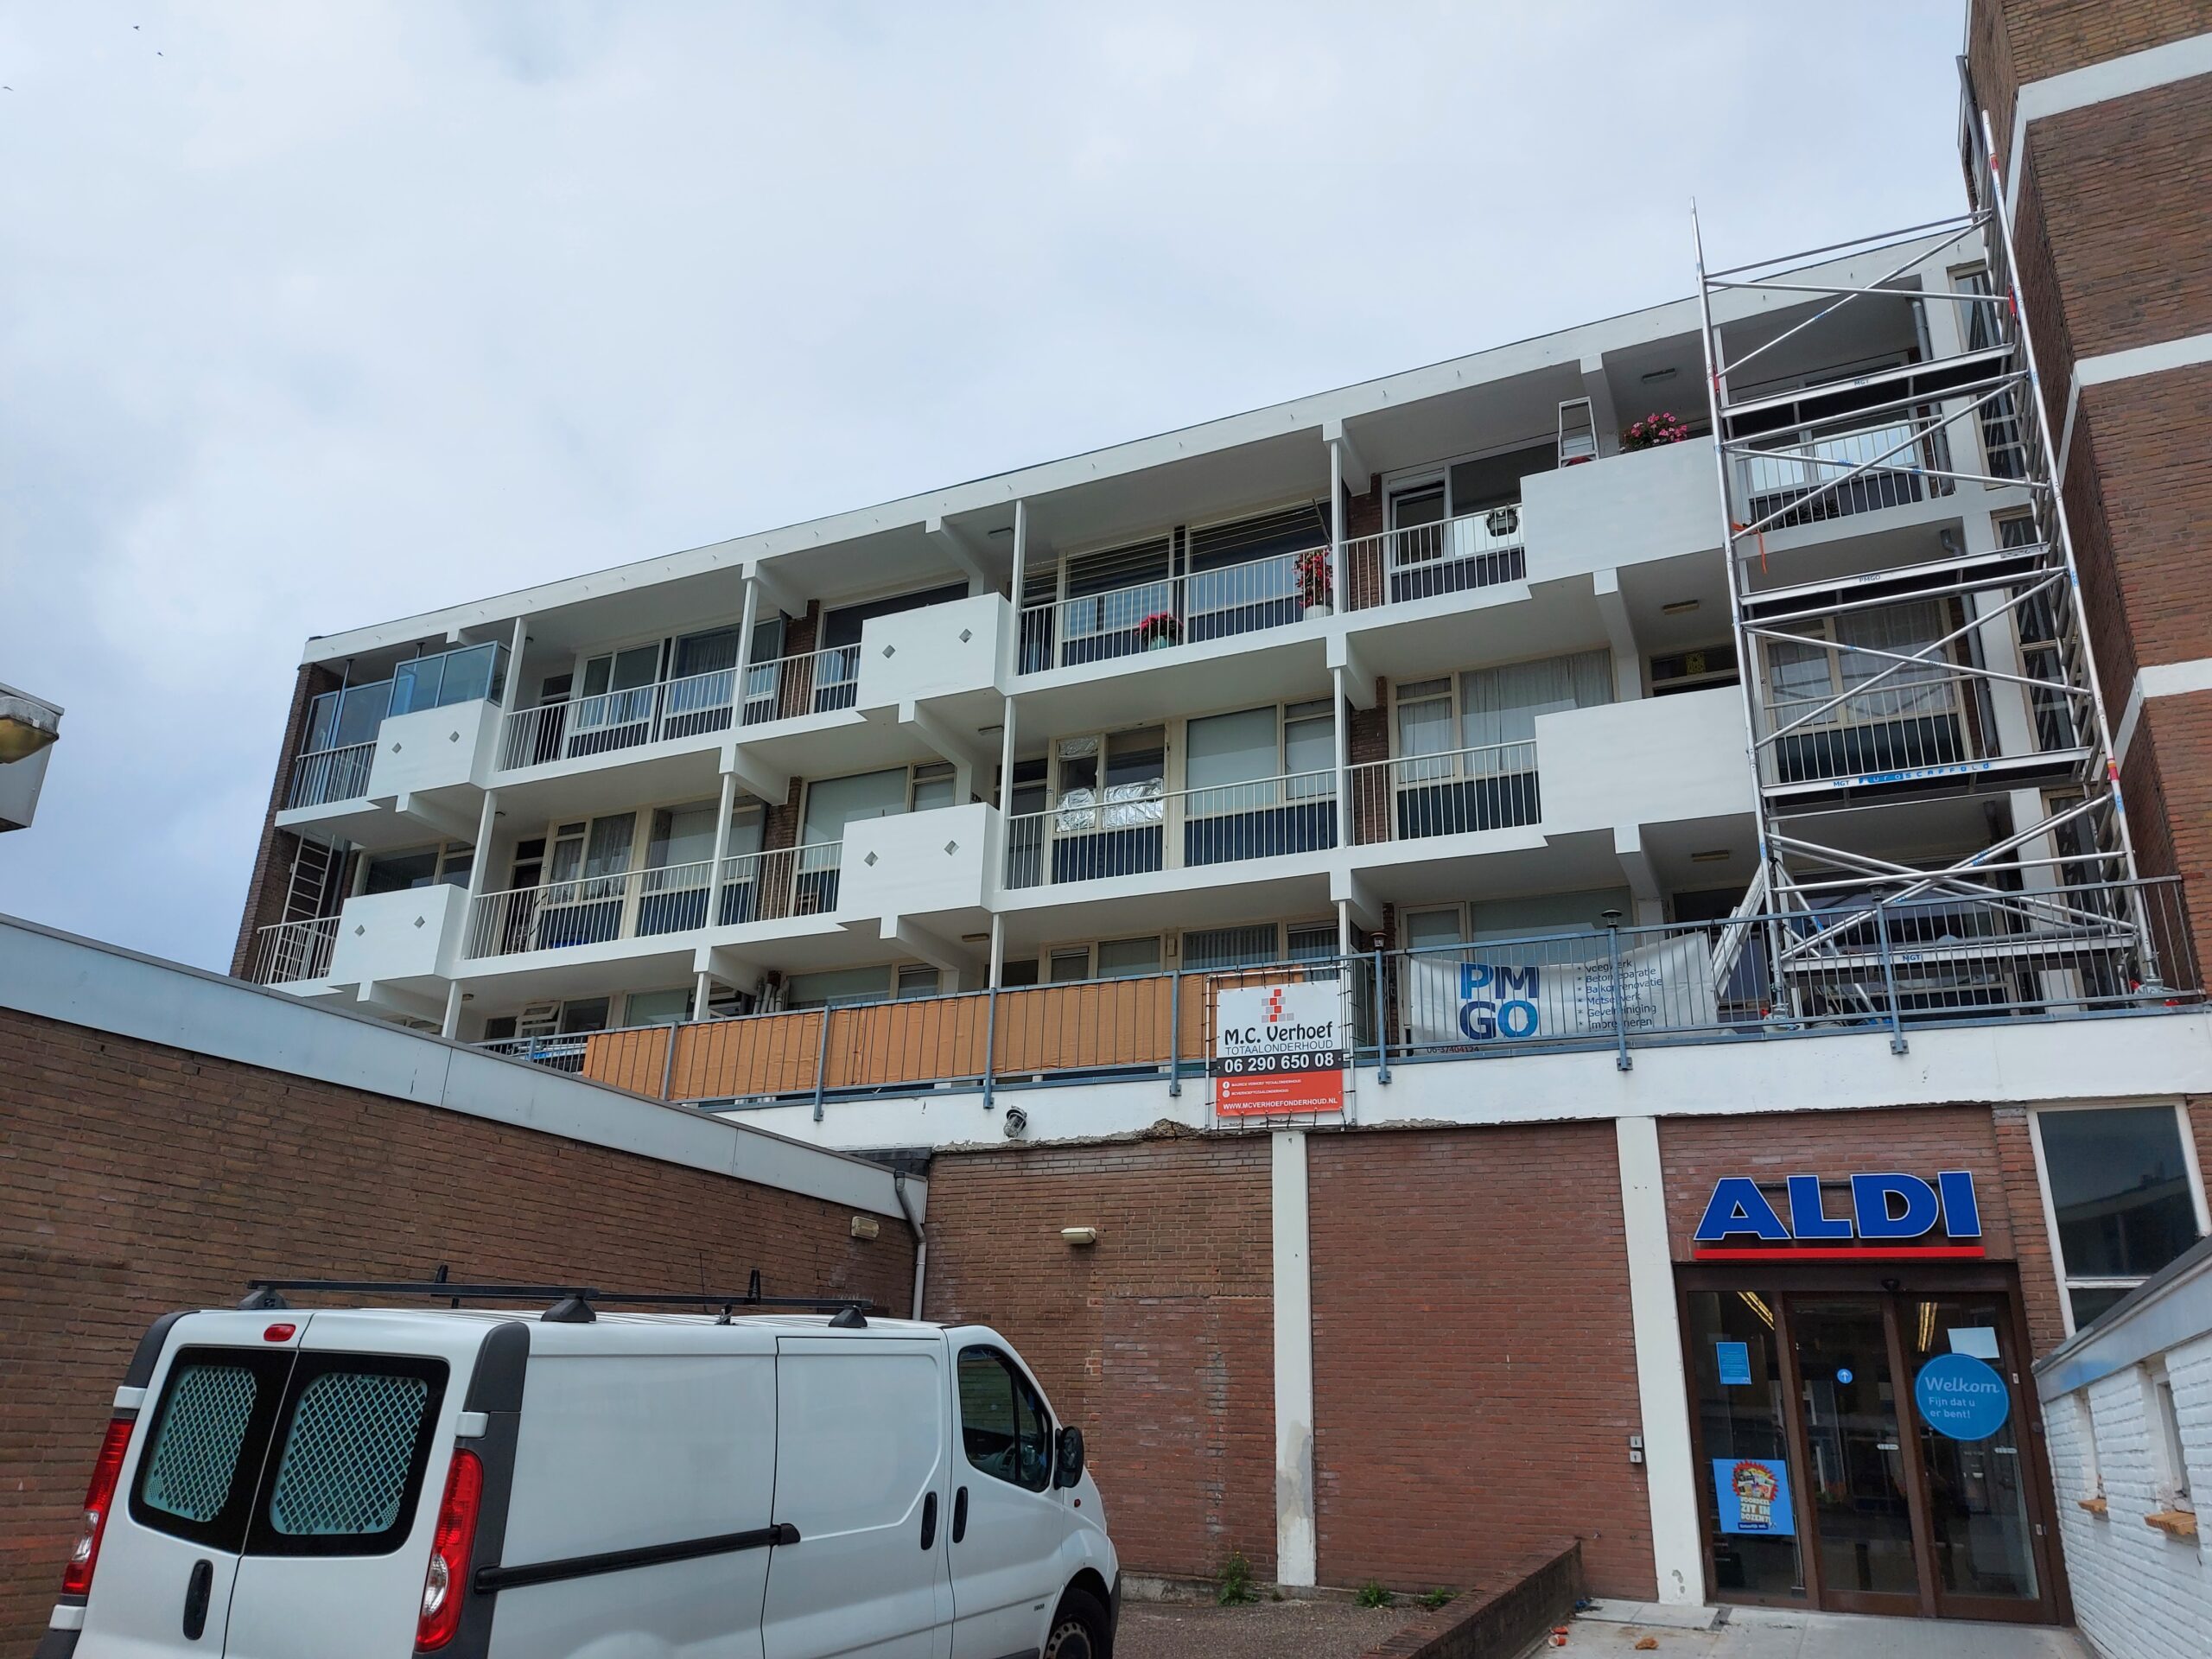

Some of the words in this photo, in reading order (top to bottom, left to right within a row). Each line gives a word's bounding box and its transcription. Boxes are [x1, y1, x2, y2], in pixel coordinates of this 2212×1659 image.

[1459, 963, 1540, 1000] PM
[1459, 1000, 1540, 1040] GO
[1224, 1027, 1262, 1046] M.C.
[1266, 1021, 1333, 1042] Verhoef
[1225, 1040, 1333, 1055] TOTAALONDERHOUD
[1224, 1058, 1243, 1073] 06
[1248, 1056, 1276, 1072] 290
[1281, 1053, 1310, 1070] 650
[1314, 1052, 1334, 1067] 08
[1223, 1098, 1338, 1109] WWW.MCVERHOEFONDERHOUD.NL
[1693, 1171, 1982, 1241] ALDI
[1924, 1376, 2000, 1394] Welkom
[1929, 1396, 1948, 1407] Fijn
[1950, 1397, 1967, 1407] dat
[1943, 1409, 1971, 1419] bent!
[1740, 1503, 1757, 1514] ZIT
[1759, 1505, 1770, 1516] IN
